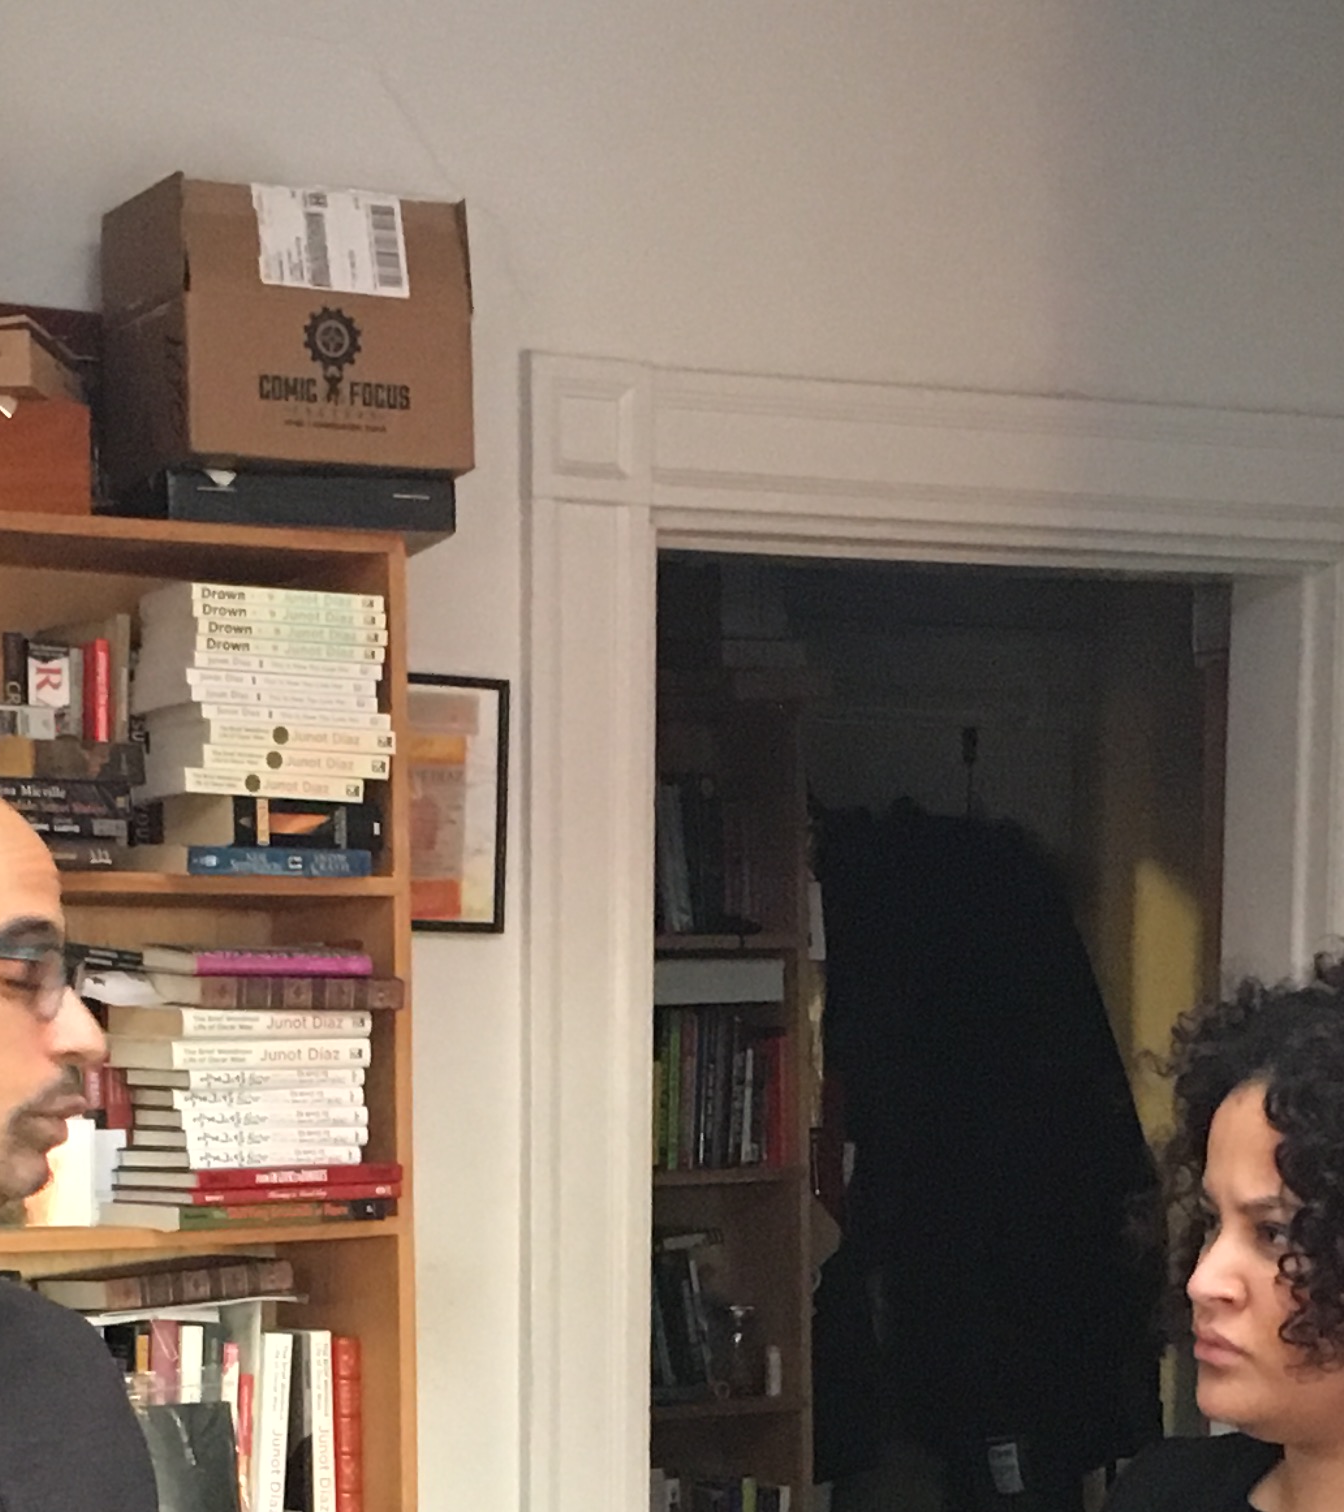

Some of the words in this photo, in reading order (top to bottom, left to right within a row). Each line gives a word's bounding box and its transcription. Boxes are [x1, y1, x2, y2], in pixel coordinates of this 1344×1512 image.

[259, 374, 318, 404] COMIC
[349, 381, 411, 410] FOCUS
[201, 588, 246, 601] Drown
[202, 604, 247, 617] Drown
[208, 621, 253, 635] Drown
[206, 638, 250, 651] Drown
[292, 732, 327, 744] Junot
[286, 755, 321, 768] Junot
[266, 1015, 307, 1030] Junot
[260, 1049, 303, 1063] Junot
[269, 1429, 283, 1475] Junot
[318, 1425, 330, 1471] Junot
